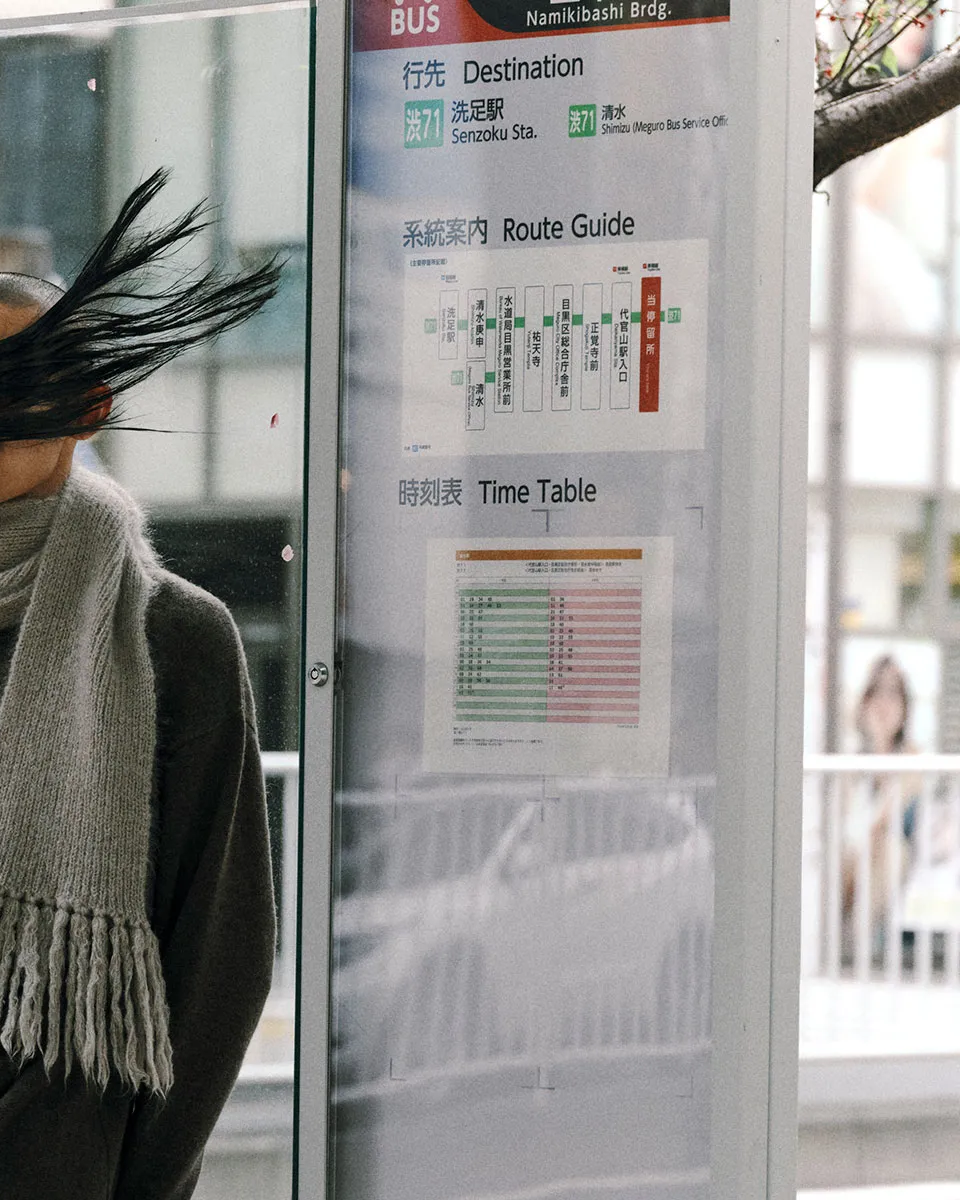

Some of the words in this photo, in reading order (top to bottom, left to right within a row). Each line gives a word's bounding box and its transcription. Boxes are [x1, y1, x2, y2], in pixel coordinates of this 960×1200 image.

[391, 4, 440, 36] BUS
[526, 3, 624, 27] Namikibashi
[630, 1, 672, 20] Brdg.
[403, 59, 446, 90] 行先
[464, 54, 584, 84] Destination
[406, 107, 440, 142] 渋71
[451, 98, 504, 124] 洗足駅
[569, 109, 594, 133] 渋71
[601, 103, 627, 121] 清水
[601, 123, 631, 135] Shimizu
[632, 120, 665, 136] (Meguro
[666, 119, 681, 130] Bus
[682, 117, 710, 129] Service
[451, 125, 508, 144] Senzoku
[512, 123, 538, 140] Sta.
[403, 215, 488, 248] 系統案内
[503, 216, 564, 242] Route
[571, 211, 636, 239] Guide
[560, 298, 570, 398] 目黒区総合庁舎前
[590, 322, 599, 372] 正覚寺前
[618, 308, 629, 383] 代官山駅入口
[398, 477, 462, 507] 時刻表
[478, 479, 530, 505] Time
[537, 477, 597, 503] Table
